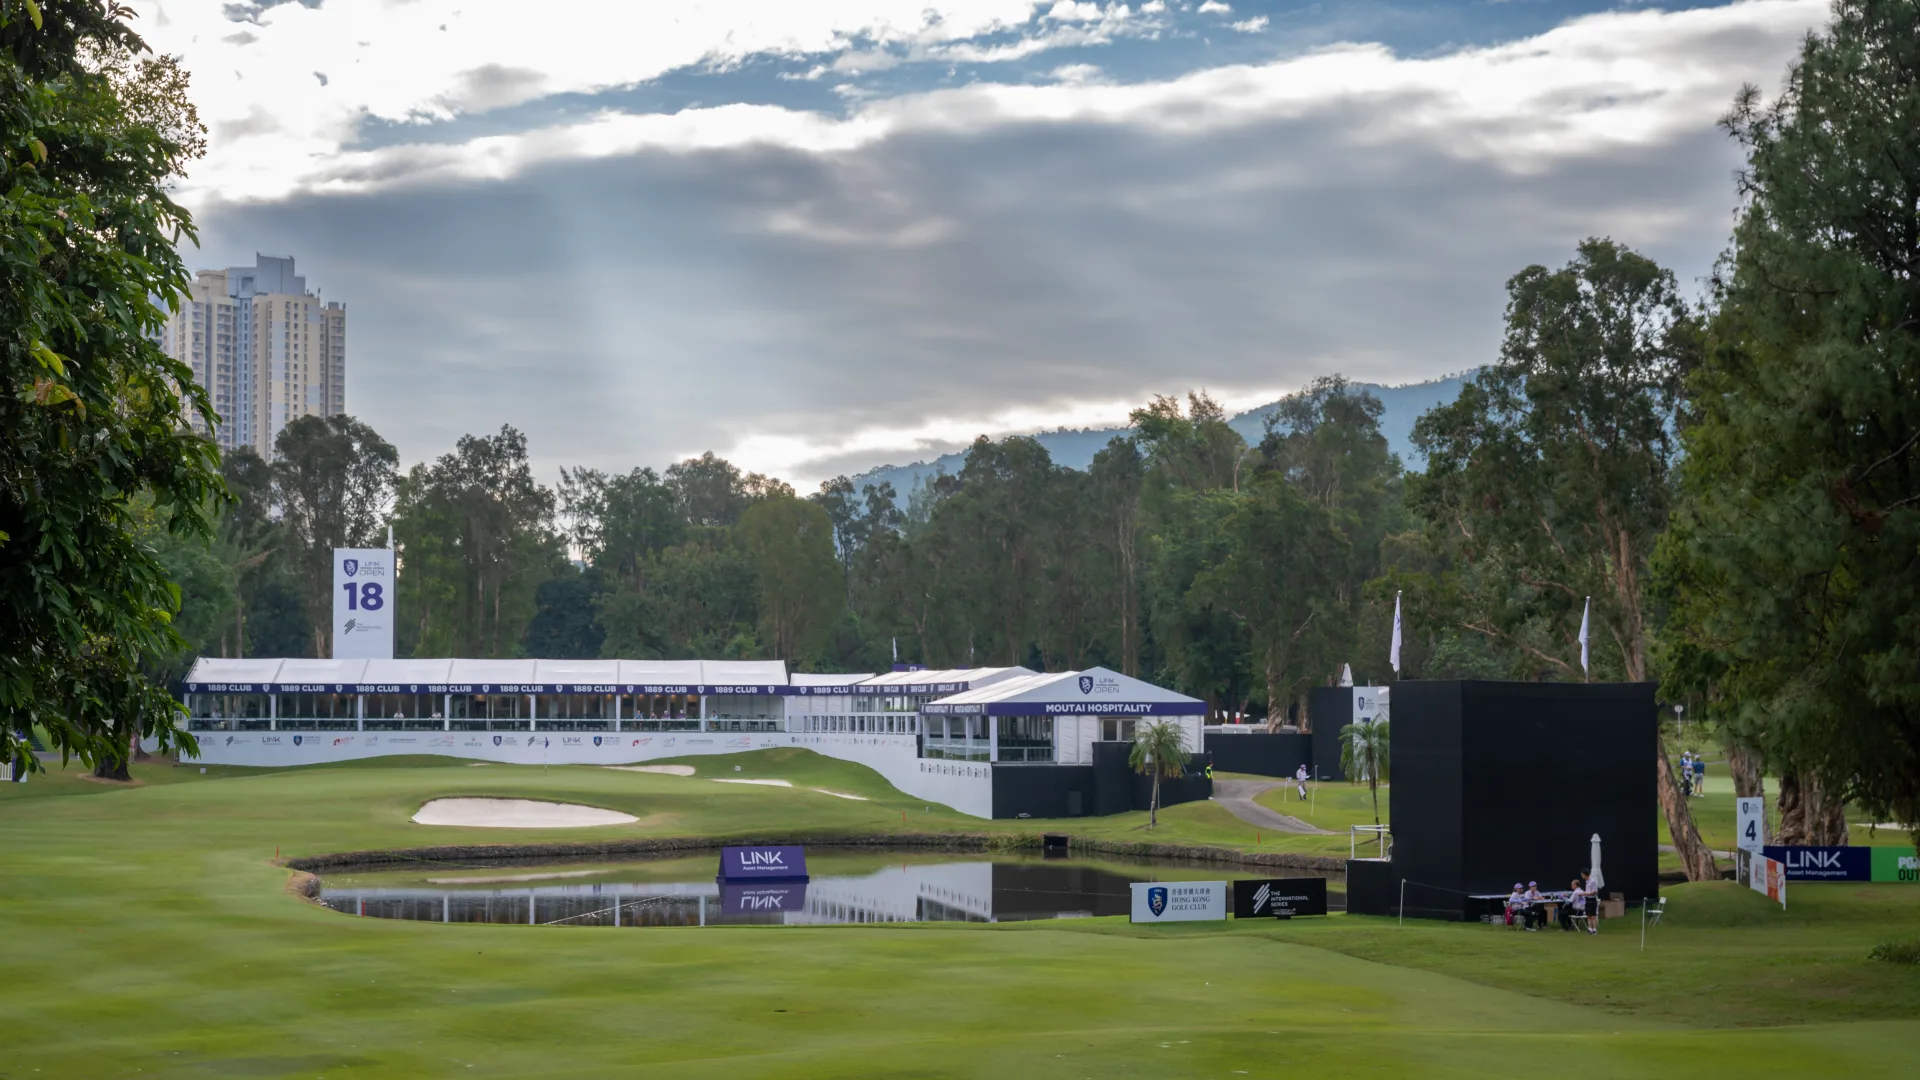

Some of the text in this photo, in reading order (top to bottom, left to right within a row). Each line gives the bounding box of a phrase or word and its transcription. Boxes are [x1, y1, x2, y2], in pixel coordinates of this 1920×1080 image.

[343, 582, 384, 611] 18
[573, 685, 617, 693] 1889 CLUB
[1094, 686, 1120, 694] OPEN
[1046, 704, 1153, 713] MOUTAI HOSPITALITY
[1745, 820, 1756, 841] 4
[740, 851, 783, 865] LINK
[1786, 851, 1841, 868] LINK
[1805, 869, 1847, 877] Management
